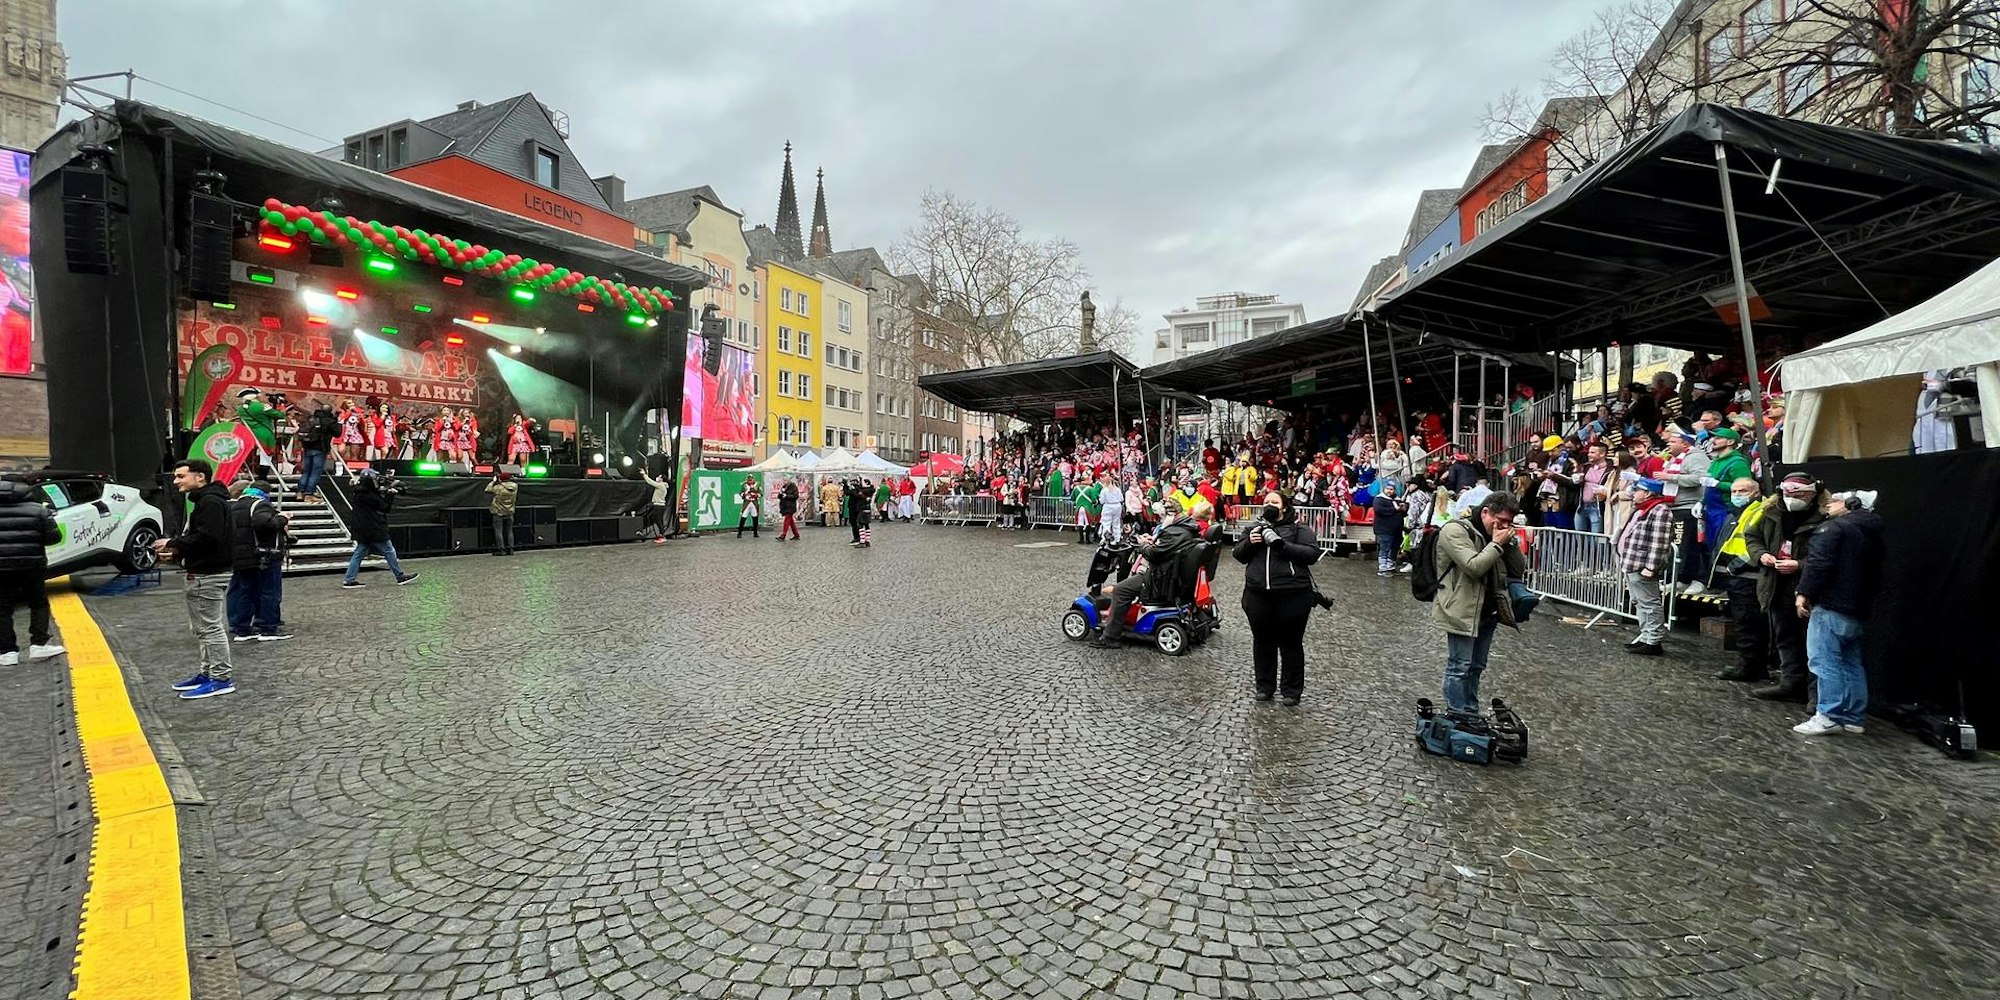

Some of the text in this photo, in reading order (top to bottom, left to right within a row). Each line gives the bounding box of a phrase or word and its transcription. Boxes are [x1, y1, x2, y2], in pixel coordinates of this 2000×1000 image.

[525, 192, 583, 226] LEGEND
[239, 365, 298, 386] DEM
[311, 372, 390, 395] ALTER
[400, 381, 474, 402] MARKT
[1673, 520, 1685, 545] Gaffel
